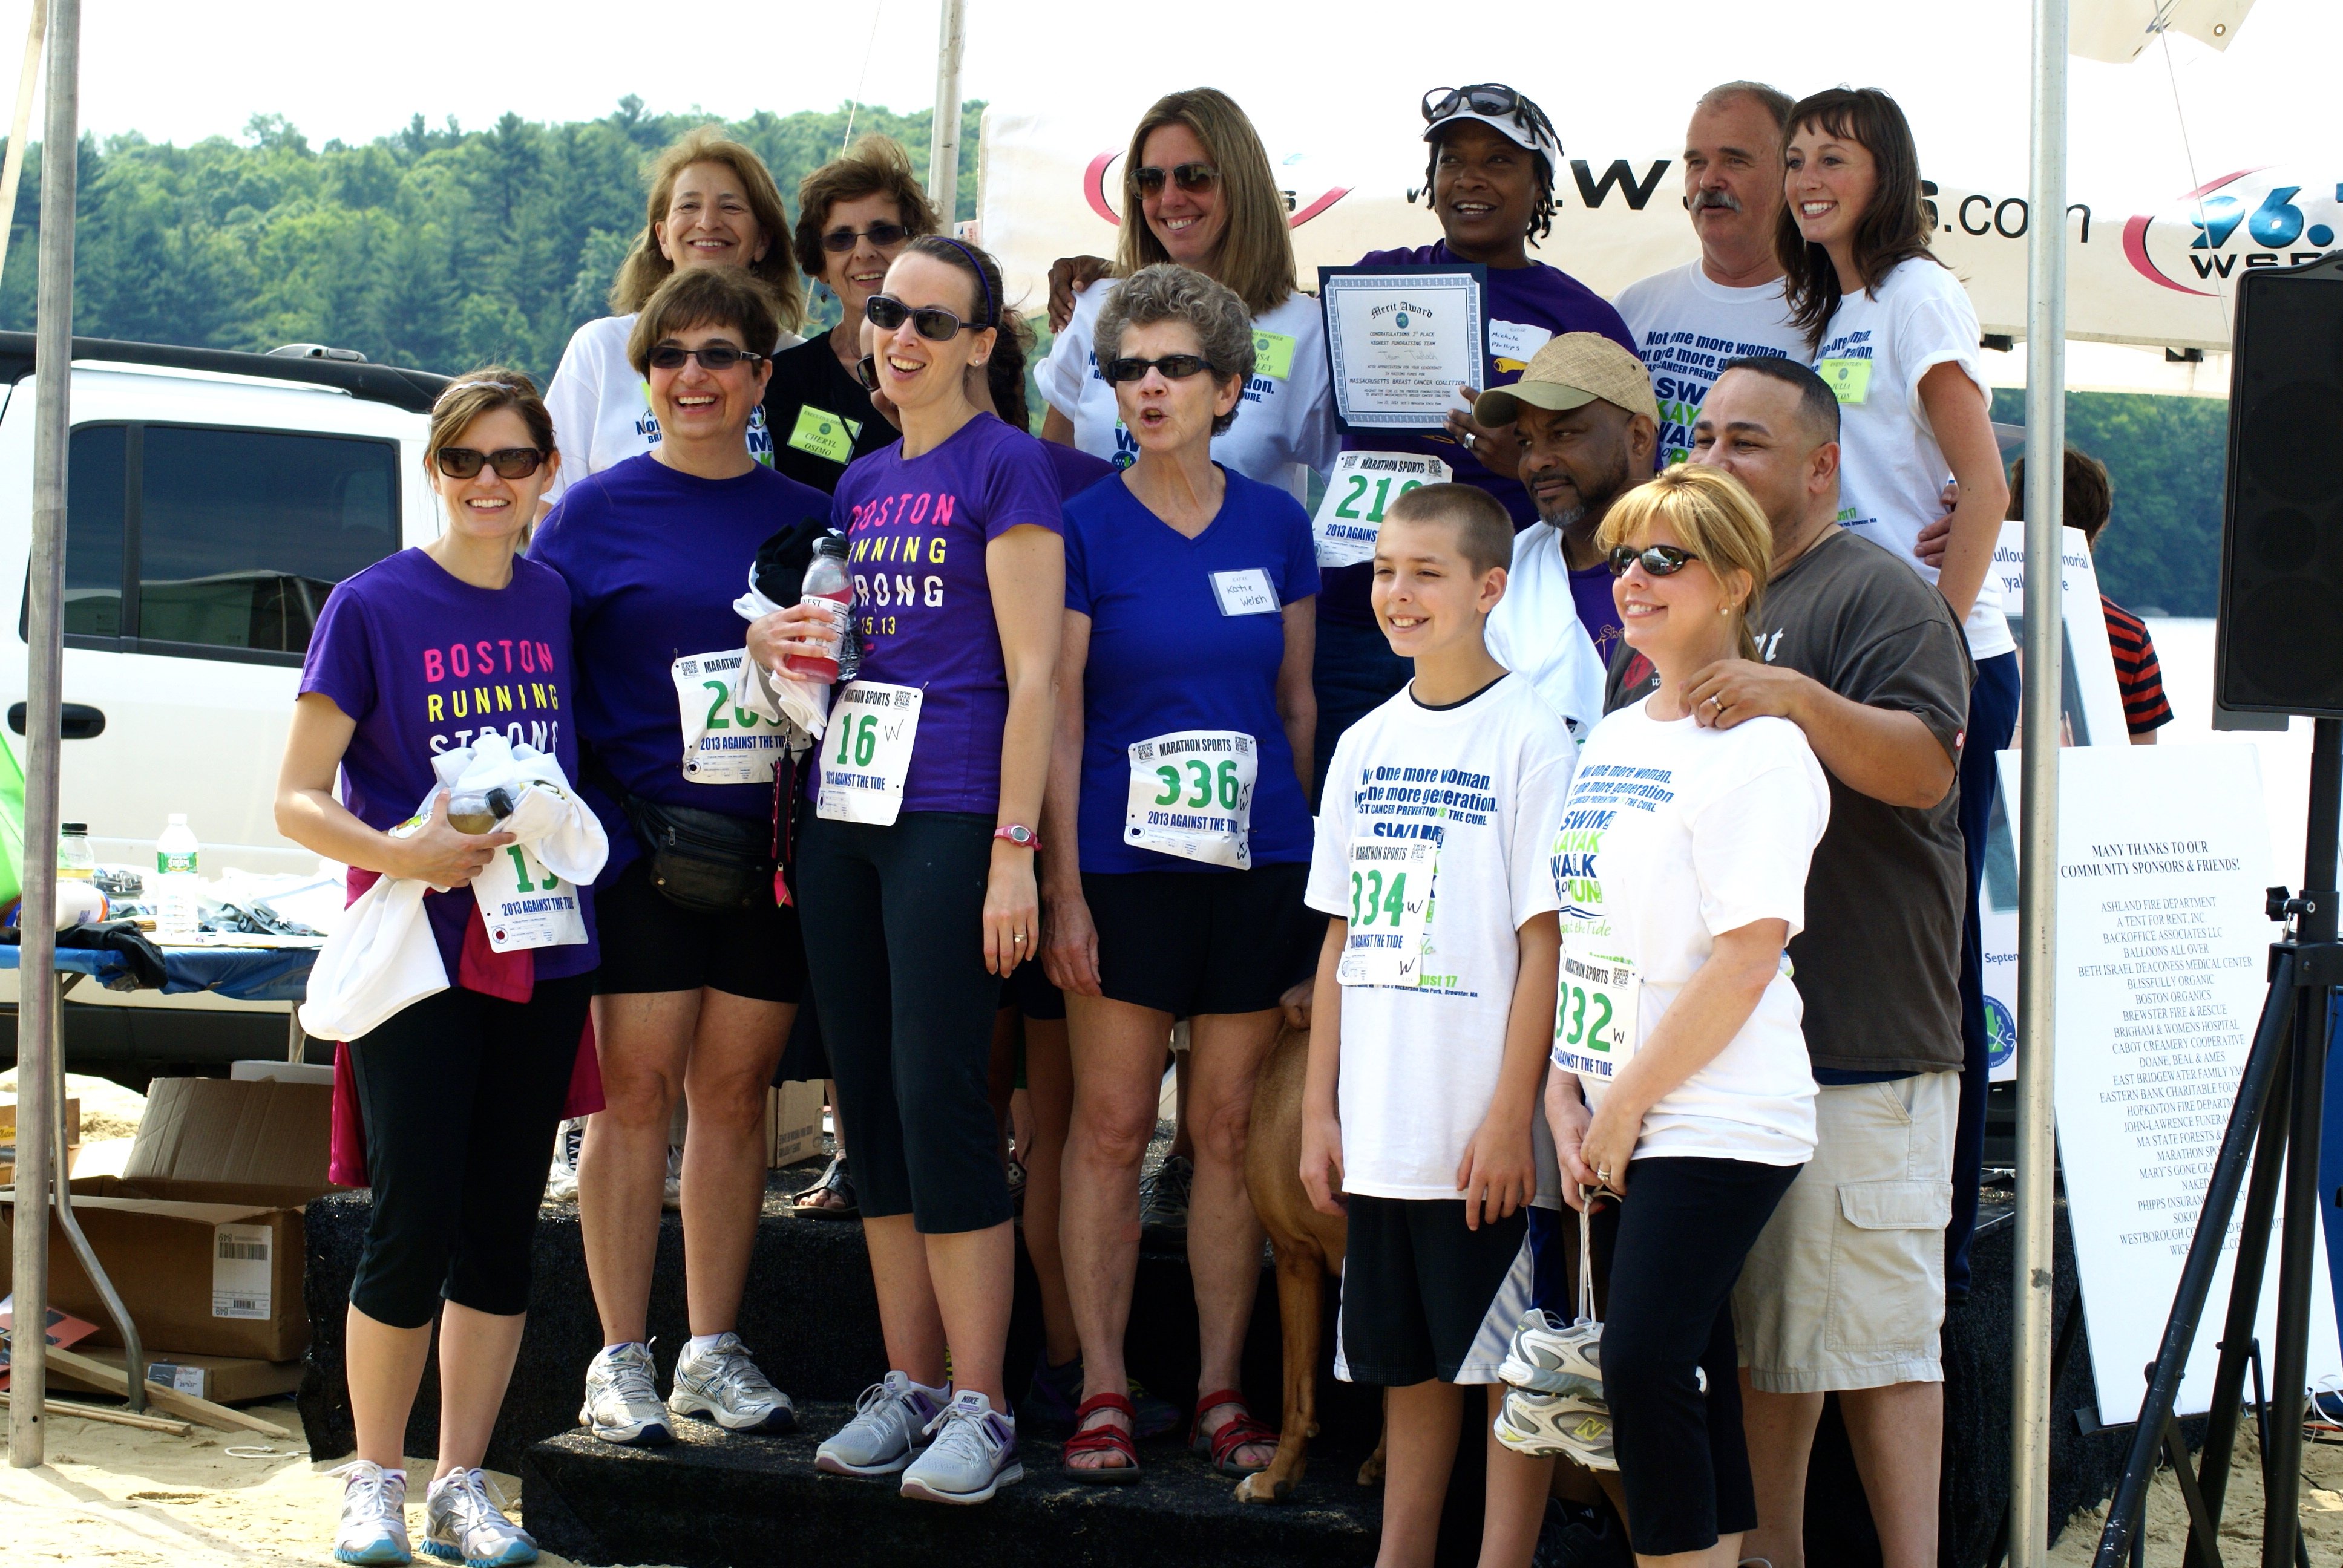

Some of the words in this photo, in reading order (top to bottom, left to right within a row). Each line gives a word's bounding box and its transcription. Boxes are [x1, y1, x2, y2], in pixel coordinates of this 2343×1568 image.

[1371, 303, 1397, 319] Merit
[1400, 302, 1432, 318] Award
[1260, 332, 1283, 341] MEMBER
[1646, 332, 1668, 345] Not
[1670, 332, 1694, 344] one
[1696, 335, 1734, 353] more
[1676, 348, 1716, 368] more
[805, 433, 837, 448] CHERYL
[804, 443, 831, 456] OSIMO
[1360, 459, 1397, 471] MARATHON
[1398, 462, 1424, 474] SPORTS
[1326, 524, 1346, 537] 2013
[1346, 526, 1378, 542] AGAINS
[854, 573, 943, 607] RONG
[1227, 584, 1253, 594] Katie
[1240, 595, 1267, 606] Welsh
[425, 640, 554, 682] BOSTON
[428, 683, 558, 722] RUNNING
[865, 690, 890, 706] SPORTS
[885, 719, 904, 742] W
[700, 737, 720, 750] 2013
[723, 736, 757, 750] AGAINST
[759, 736, 773, 748] THE
[837, 713, 878, 767] 16
[1159, 740, 1201, 756] MARATHON
[1202, 739, 1231, 751] SPORTS
[834, 772, 856, 787] AGAINST
[857, 775, 868, 788] THE
[870, 777, 885, 790] TIDE
[1375, 766, 1401, 780] one
[1403, 768, 1438, 782] more
[1591, 765, 1611, 776] one
[1608, 766, 1636, 777] more
[1634, 768, 1671, 784] woman.
[1155, 760, 1239, 810] 336
[1587, 782, 1614, 794] more
[1386, 787, 1421, 803] more
[1625, 798, 1639, 807] THE
[1371, 804, 1395, 814] CANCER
[1449, 809, 1464, 822] THE
[1560, 810, 1617, 831] SWIM
[1148, 812, 1168, 825] 2013
[1170, 814, 1208, 829] AGAINST
[1210, 818, 1224, 831] THE
[1227, 819, 1238, 834] TIDE
[1553, 831, 1605, 854] KAYAK
[2092, 843, 2123, 858] MANY
[2127, 842, 2169, 855] THANKS
[2171, 842, 2185, 854] TO
[2187, 841, 2208, 854] OUR
[1356, 846, 1383, 860] MARATHON
[1382, 847, 1407, 860] SPORTS
[1551, 854, 1597, 879] WALK
[2061, 861, 2129, 878] COMMUNITY
[2132, 860, 2184, 874] SPONSORS
[2187, 860, 2194, 872] &
[2197, 858, 2240, 871] FRIENDS!
[502, 901, 522, 916] 2013
[523, 898, 551, 913] AGAINST
[551, 897, 564, 909] THE
[563, 897, 574, 909] TIDE
[1351, 869, 1406, 927] 334
[1407, 900, 1423, 913] W
[2101, 900, 2141, 912] ASHLAND
[2143, 899, 2161, 910] FIRE
[2164, 897, 2216, 909] DEPARTMENT
[1587, 920, 1611, 936] Tide
[2117, 918, 2123, 927] A
[2125, 916, 2146, 926] TENT
[2149, 915, 2164, 925] FOR
[2167, 913, 2190, 925] RENT,
[2192, 912, 2207, 923] INC.
[1374, 935, 1384, 948] THE
[1387, 935, 1403, 949] TIDE
[2103, 930, 2155, 944] BACKOFFICE
[2159, 928, 2206, 940] ASSOCIATES
[2208, 927, 2222, 938] LLC
[2123, 946, 2168, 958] BALLOONS
[2171, 945, 2185, 955] ALL
[2187, 943, 2209, 955] OVER
[1400, 957, 1415, 975] W
[1585, 965, 1608, 984] SPORTS
[2079, 966, 2102, 977] BETH
[2104, 964, 2133, 975] ISRAEL
[2136, 961, 2184, 973] DEACONESS
[2186, 958, 2221, 970] MEDICAL
[2223, 956, 2252, 968] CENTER
[1446, 975, 1458, 987] 17
[2128, 976, 2176, 990] BLISSFULLY
[2179, 975, 2214, 987] ORGANIC
[2135, 993, 2169, 1005] BOSTON
[2171, 990, 2212, 1002] ORGANICS
[1556, 981, 1612, 1052] 332
[1984, 998, 1999, 1007] Cancer
[1999, 1006, 2012, 1027] Coalition
[2123, 1008, 2168, 1021] BREWSTER
[2170, 1007, 2187, 1018] FIRE
[2190, 1007, 2195, 1017] &
[2197, 1004, 2227, 1016] RESCUE
[1614, 1028, 1624, 1044] W
[2114, 1025, 2154, 1038] BRIGHAM
[2157, 1025, 2162, 1035] &
[2164, 1022, 2200, 1034] WOMENS
[2202, 1019, 2239, 1031] HOSPITAL
[2112, 1042, 2141, 1053] CABOT
[2143, 1038, 2189, 1052] CREAMERY
[2191, 1034, 2244, 1048] COOPERATIVE
[1581, 1057, 1593, 1072] THE
[1596, 1060, 1613, 1076] TIDE
[2140, 1055, 2171, 1068] DOANE,
[2173, 1054, 2194, 1066] BEAL
[2196, 1053, 2201, 1063] &
[2204, 1051, 2226, 1062] AMES
[2113, 1074, 2134, 1085] EAST
[2137, 1070, 2196, 1084] BRIDGEWATER
[2198, 1067, 2227, 1079] FAMILY
[961, 1395, 979, 1405] NIKE
